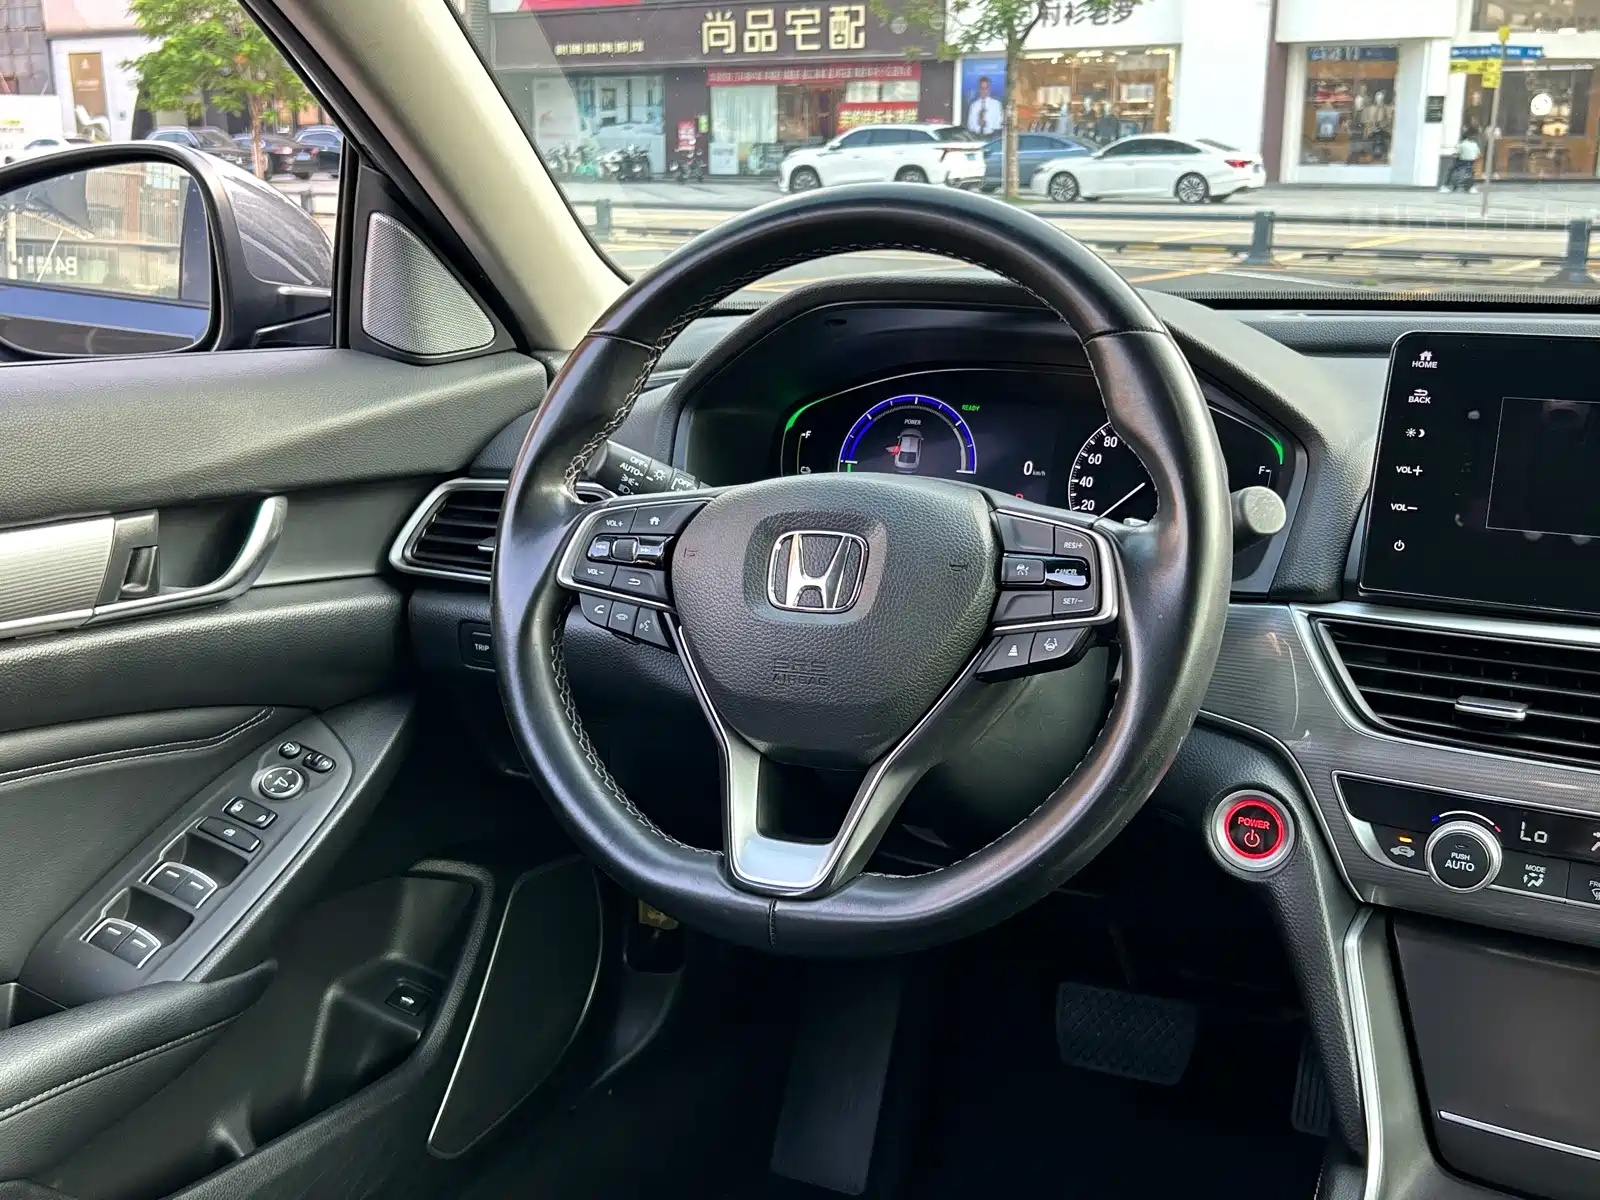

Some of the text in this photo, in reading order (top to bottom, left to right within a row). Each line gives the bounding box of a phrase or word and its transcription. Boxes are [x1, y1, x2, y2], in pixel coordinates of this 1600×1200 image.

[702, 4, 866, 54] 尚品宅配
[1411, 360, 1437, 369] HOME
[1408, 395, 1431, 404] BACK
[961, 404, 980, 412] READY
[904, 418, 922, 426] POWER
[804, 430, 812, 439] F
[1103, 436, 1118, 449] 80
[629, 456, 645, 468] OFF
[1087, 453, 1102, 465] 60
[619, 462, 641, 476] AUTO
[1023, 460, 1033, 476] 0
[1258, 465, 1266, 475] F
[1396, 465, 1423, 476] VOL+
[676, 477, 693, 488] OFF
[1079, 476, 1094, 488] 40
[1080, 499, 1095, 511] 20
[1054, 568, 1078, 576] CANCEL
[474, 643, 490, 652] TRIP
[1237, 816, 1271, 830] POWER
[1450, 851, 1471, 861] PUSH
[1444, 859, 1475, 872] AUTO
[1525, 863, 1547, 874] MODE
